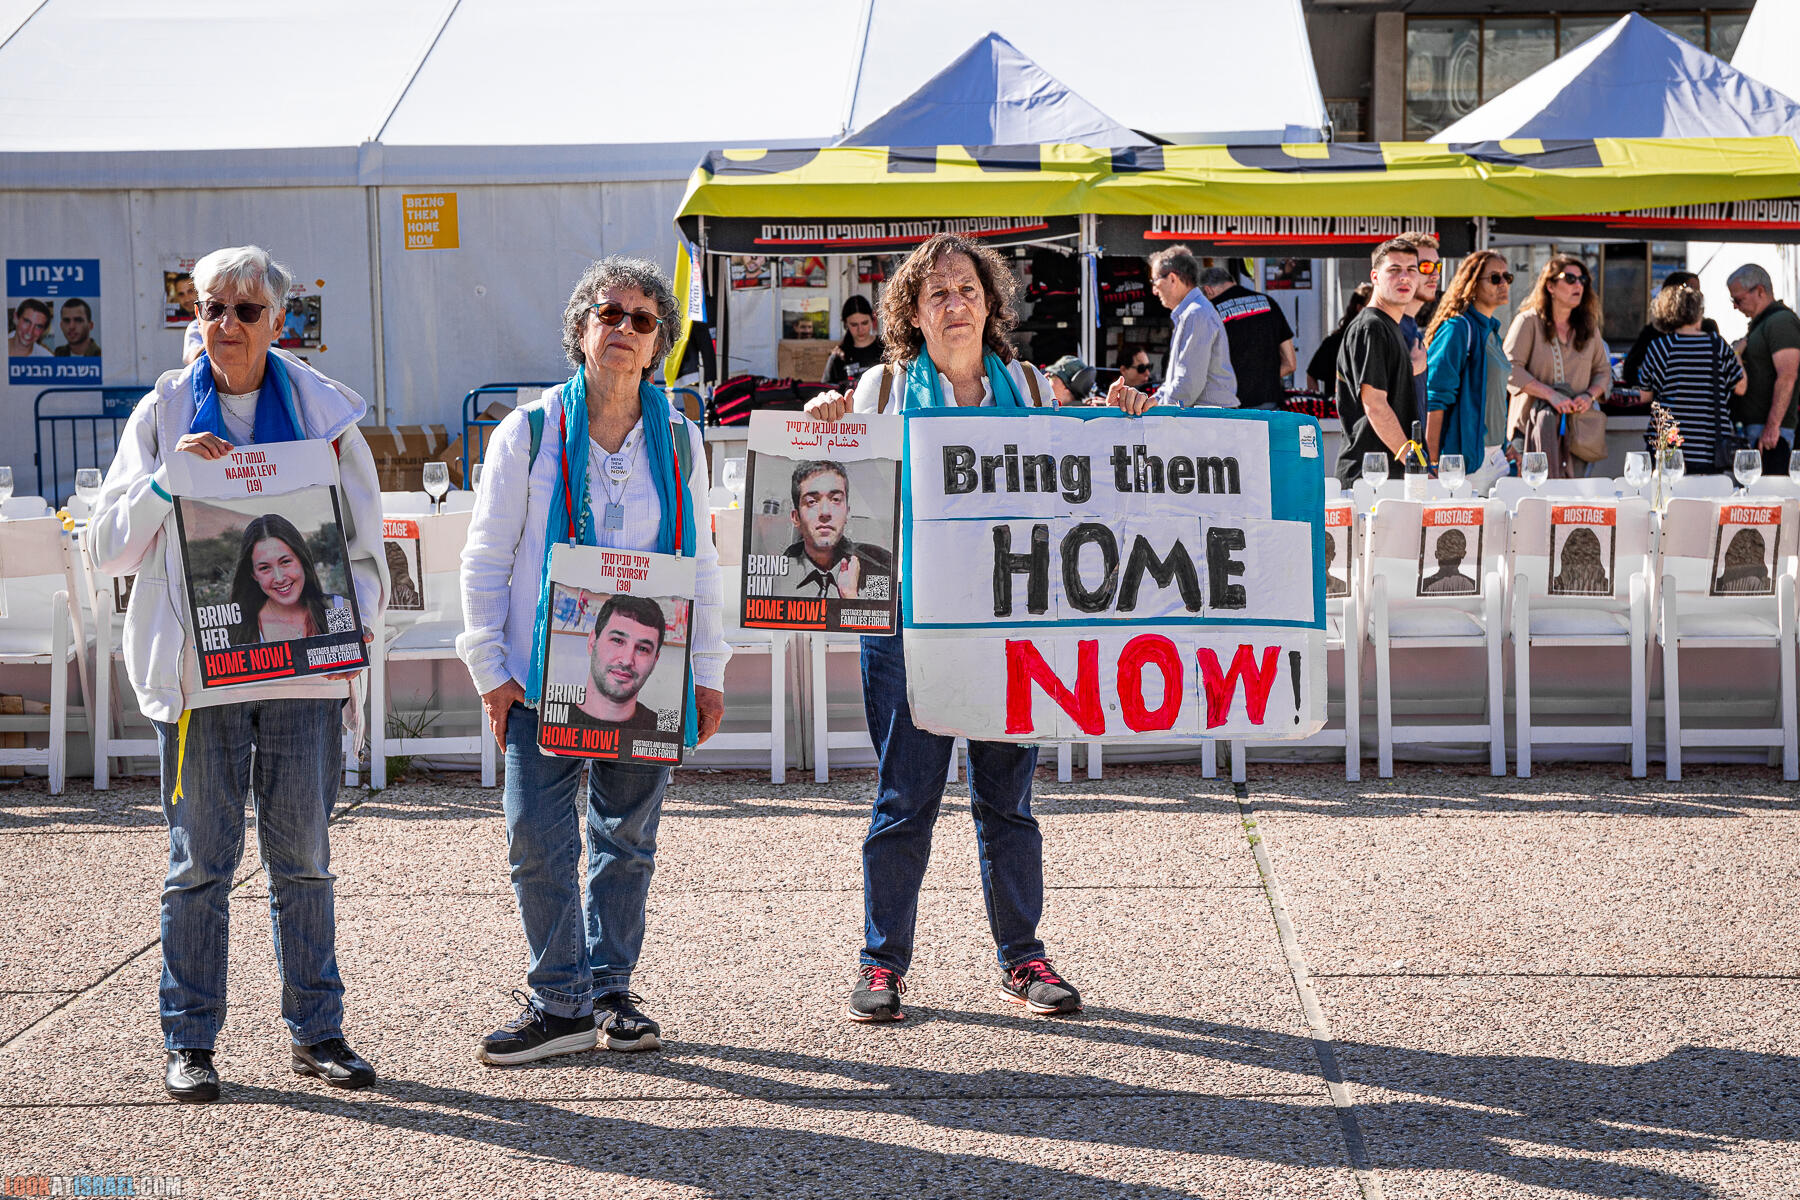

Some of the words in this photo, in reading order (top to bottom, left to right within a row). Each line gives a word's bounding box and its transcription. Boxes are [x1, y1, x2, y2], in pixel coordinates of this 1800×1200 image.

[406, 197, 446, 208] BRING
[407, 210, 439, 220] THEM
[408, 222, 440, 232] HOME
[761, 224, 825, 241] והנעדרים
[827, 222, 886, 240] החטופים
[889, 219, 941, 237] להחזרת
[1152, 215, 1214, 234] והנעדרים
[1217, 215, 1276, 235] החטופים
[1279, 215, 1331, 235] להחזרת
[1334, 215, 1401, 236] המשפחות
[408, 234, 434, 245] NOW
[20, 266, 84, 287] ניצחון
[10, 364, 53, 378] הבנים
[56, 364, 100, 378] השבת
[812, 421, 838, 435] שעבאן
[840, 422, 867, 435] הישאם
[791, 435, 822, 450] السيد
[826, 435, 859, 454] هشام
[230, 452, 243, 465] לוי
[245, 451, 267, 465] נעמה
[225, 465, 257, 480] NAAMA
[257, 464, 277, 477] LEVY
[943, 443, 1092, 504] Bring
[1110, 444, 1241, 495] them
[246, 479, 263, 493] (19)
[1434, 510, 1474, 524] HOSTAGE
[1563, 509, 1605, 524] HOSTAGE
[1730, 509, 1772, 523] HOSTAGE
[383, 523, 408, 536] STAGE
[600, 552, 632, 567] סבירסקי
[633, 555, 650, 569] איתי
[747, 555, 789, 577] BRING
[601, 565, 615, 577] ITAI
[616, 566, 648, 581] SVIRSKY
[992, 522, 1247, 618] HOME
[616, 579, 631, 593] (38)
[746, 576, 773, 596] HIM
[197, 602, 243, 629] BRING
[746, 599, 784, 620] HOME
[787, 599, 827, 622] NOW!
[840, 615, 867, 626] FAMILIES
[868, 616, 890, 627] FORUM
[200, 627, 231, 652] HER
[204, 650, 249, 677] HOME
[249, 641, 293, 671] NOW!
[308, 653, 338, 667] FAMILIES
[338, 649, 362, 662] FORUM
[1005, 633, 1301, 736] NOW!
[546, 683, 587, 706] BRING
[543, 703, 570, 724] HIM
[542, 725, 580, 749] HOME
[582, 728, 620, 752] NOW!
[632, 746, 658, 758] FAMILIES
[658, 748, 679, 759] FORUM
